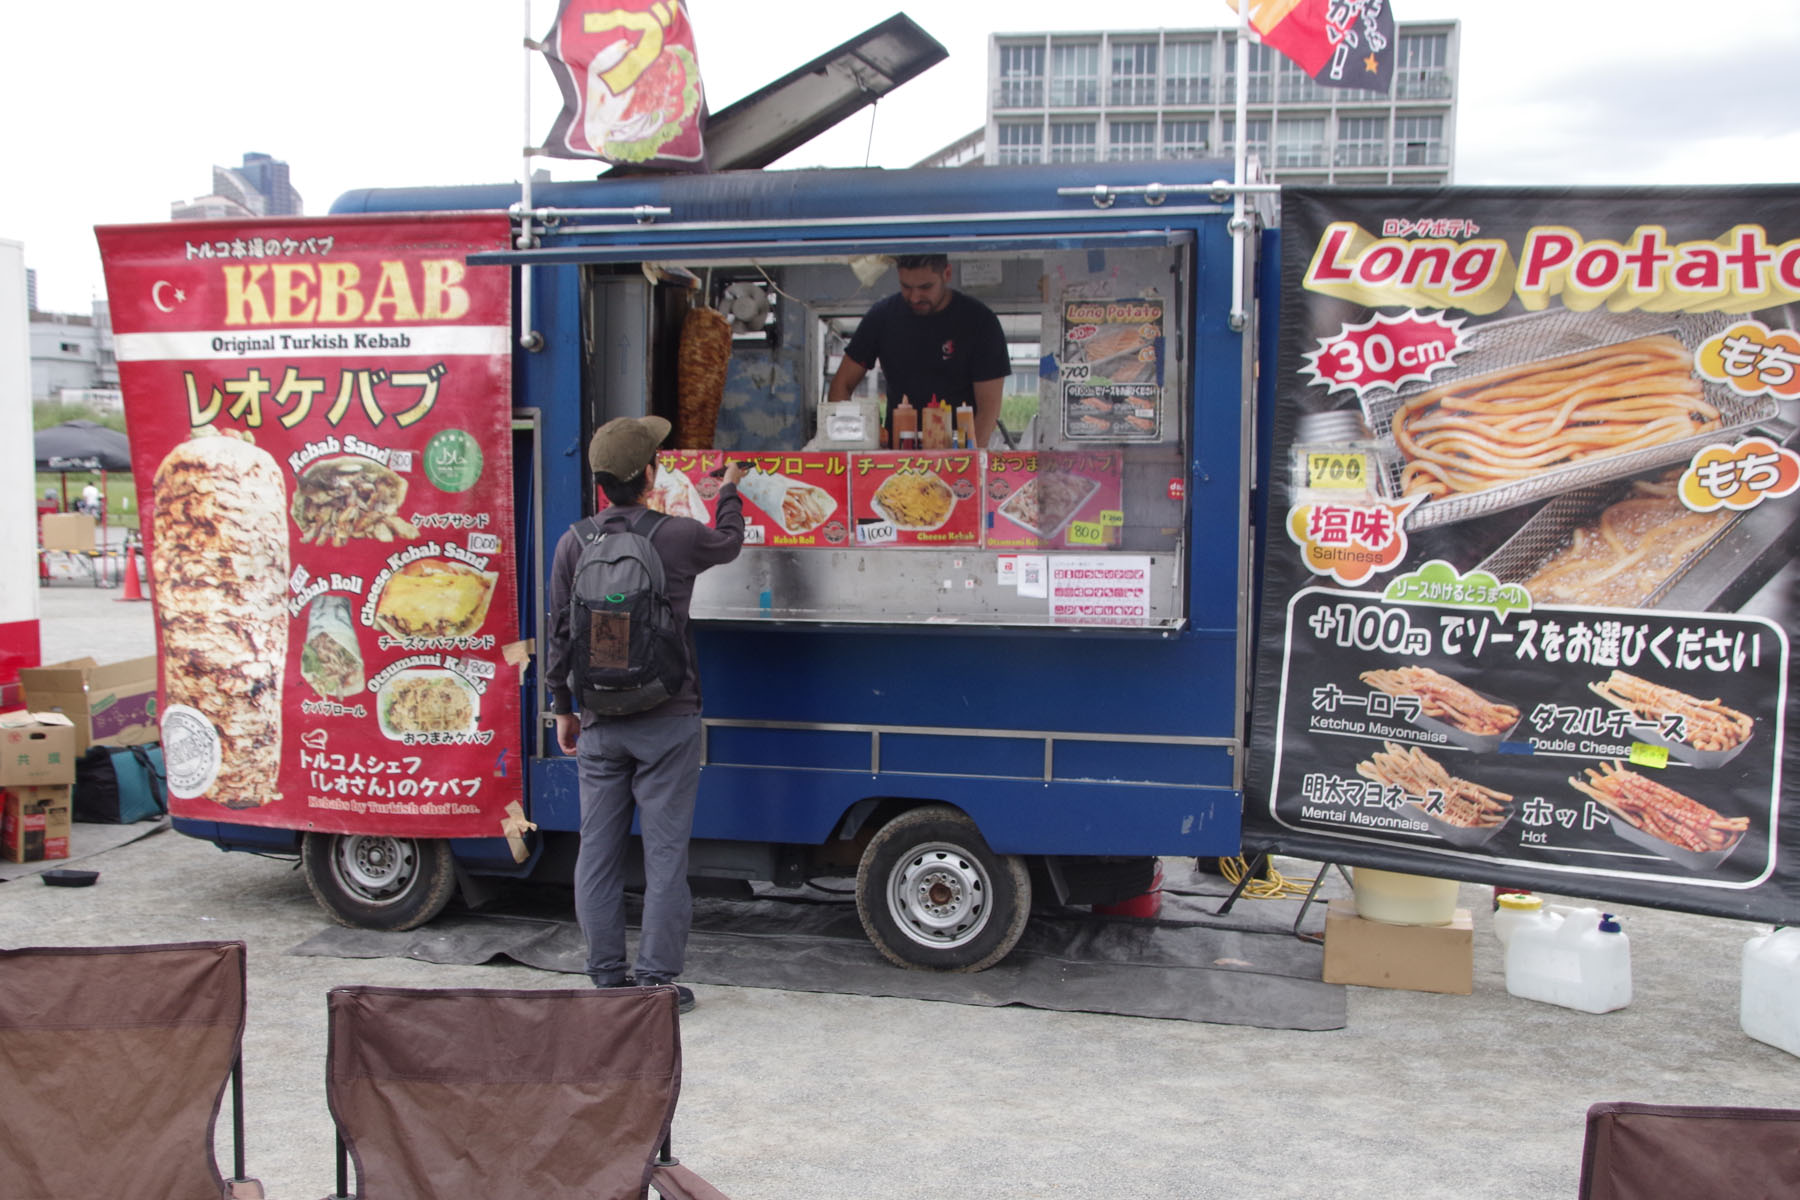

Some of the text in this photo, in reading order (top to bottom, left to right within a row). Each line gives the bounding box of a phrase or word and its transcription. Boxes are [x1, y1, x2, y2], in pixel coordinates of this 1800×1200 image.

[1382, 218, 1480, 238] ロングポテト
[185, 236, 334, 260] トルコ本場のケバブ
[1308, 228, 1501, 295] Long
[222, 258, 471, 326] KEBAB
[212, 332, 411, 354] Original Turkish Kebab
[1718, 335, 1800, 386] もち
[183, 362, 447, 429] レオケバブ
[287, 434, 392, 474] Kebab Sand
[857, 454, 973, 476] チーズケバブ
[1313, 457, 1361, 480] 700
[1696, 453, 1781, 499] もち
[1074, 525, 1100, 540] 800
[1310, 505, 1390, 547] 塩味
[1313, 546, 1384, 563] Saltiness
[287, 576, 329, 618] Kebab
[329, 572, 363, 595] Roll
[360, 541, 490, 627] Cheese Kebab Sand
[378, 634, 496, 650] チーズケバブサンド
[1440, 615, 1760, 673] でソースをお選びください
[367, 653, 441, 693] Otsumami
[1312, 683, 1422, 723] オーロラ
[403, 730, 496, 746] おつまみケバブ
[1310, 715, 1448, 744] Ketchup Mayonnaise
[1529, 703, 1687, 743] ダブルチーズ
[1529, 737, 1576, 752] Double
[1580, 740, 1632, 755] Cheese
[300, 749, 422, 775] トルコ人シェフ
[367, 801, 419, 815] Turkish
[419, 803, 451, 815] chef
[1302, 773, 1446, 817] 明太マヨネーズ
[1301, 806, 1430, 832] Mentai Mayonnaise
[1521, 796, 1609, 829] ホット
[1521, 829, 1547, 844] Hot
